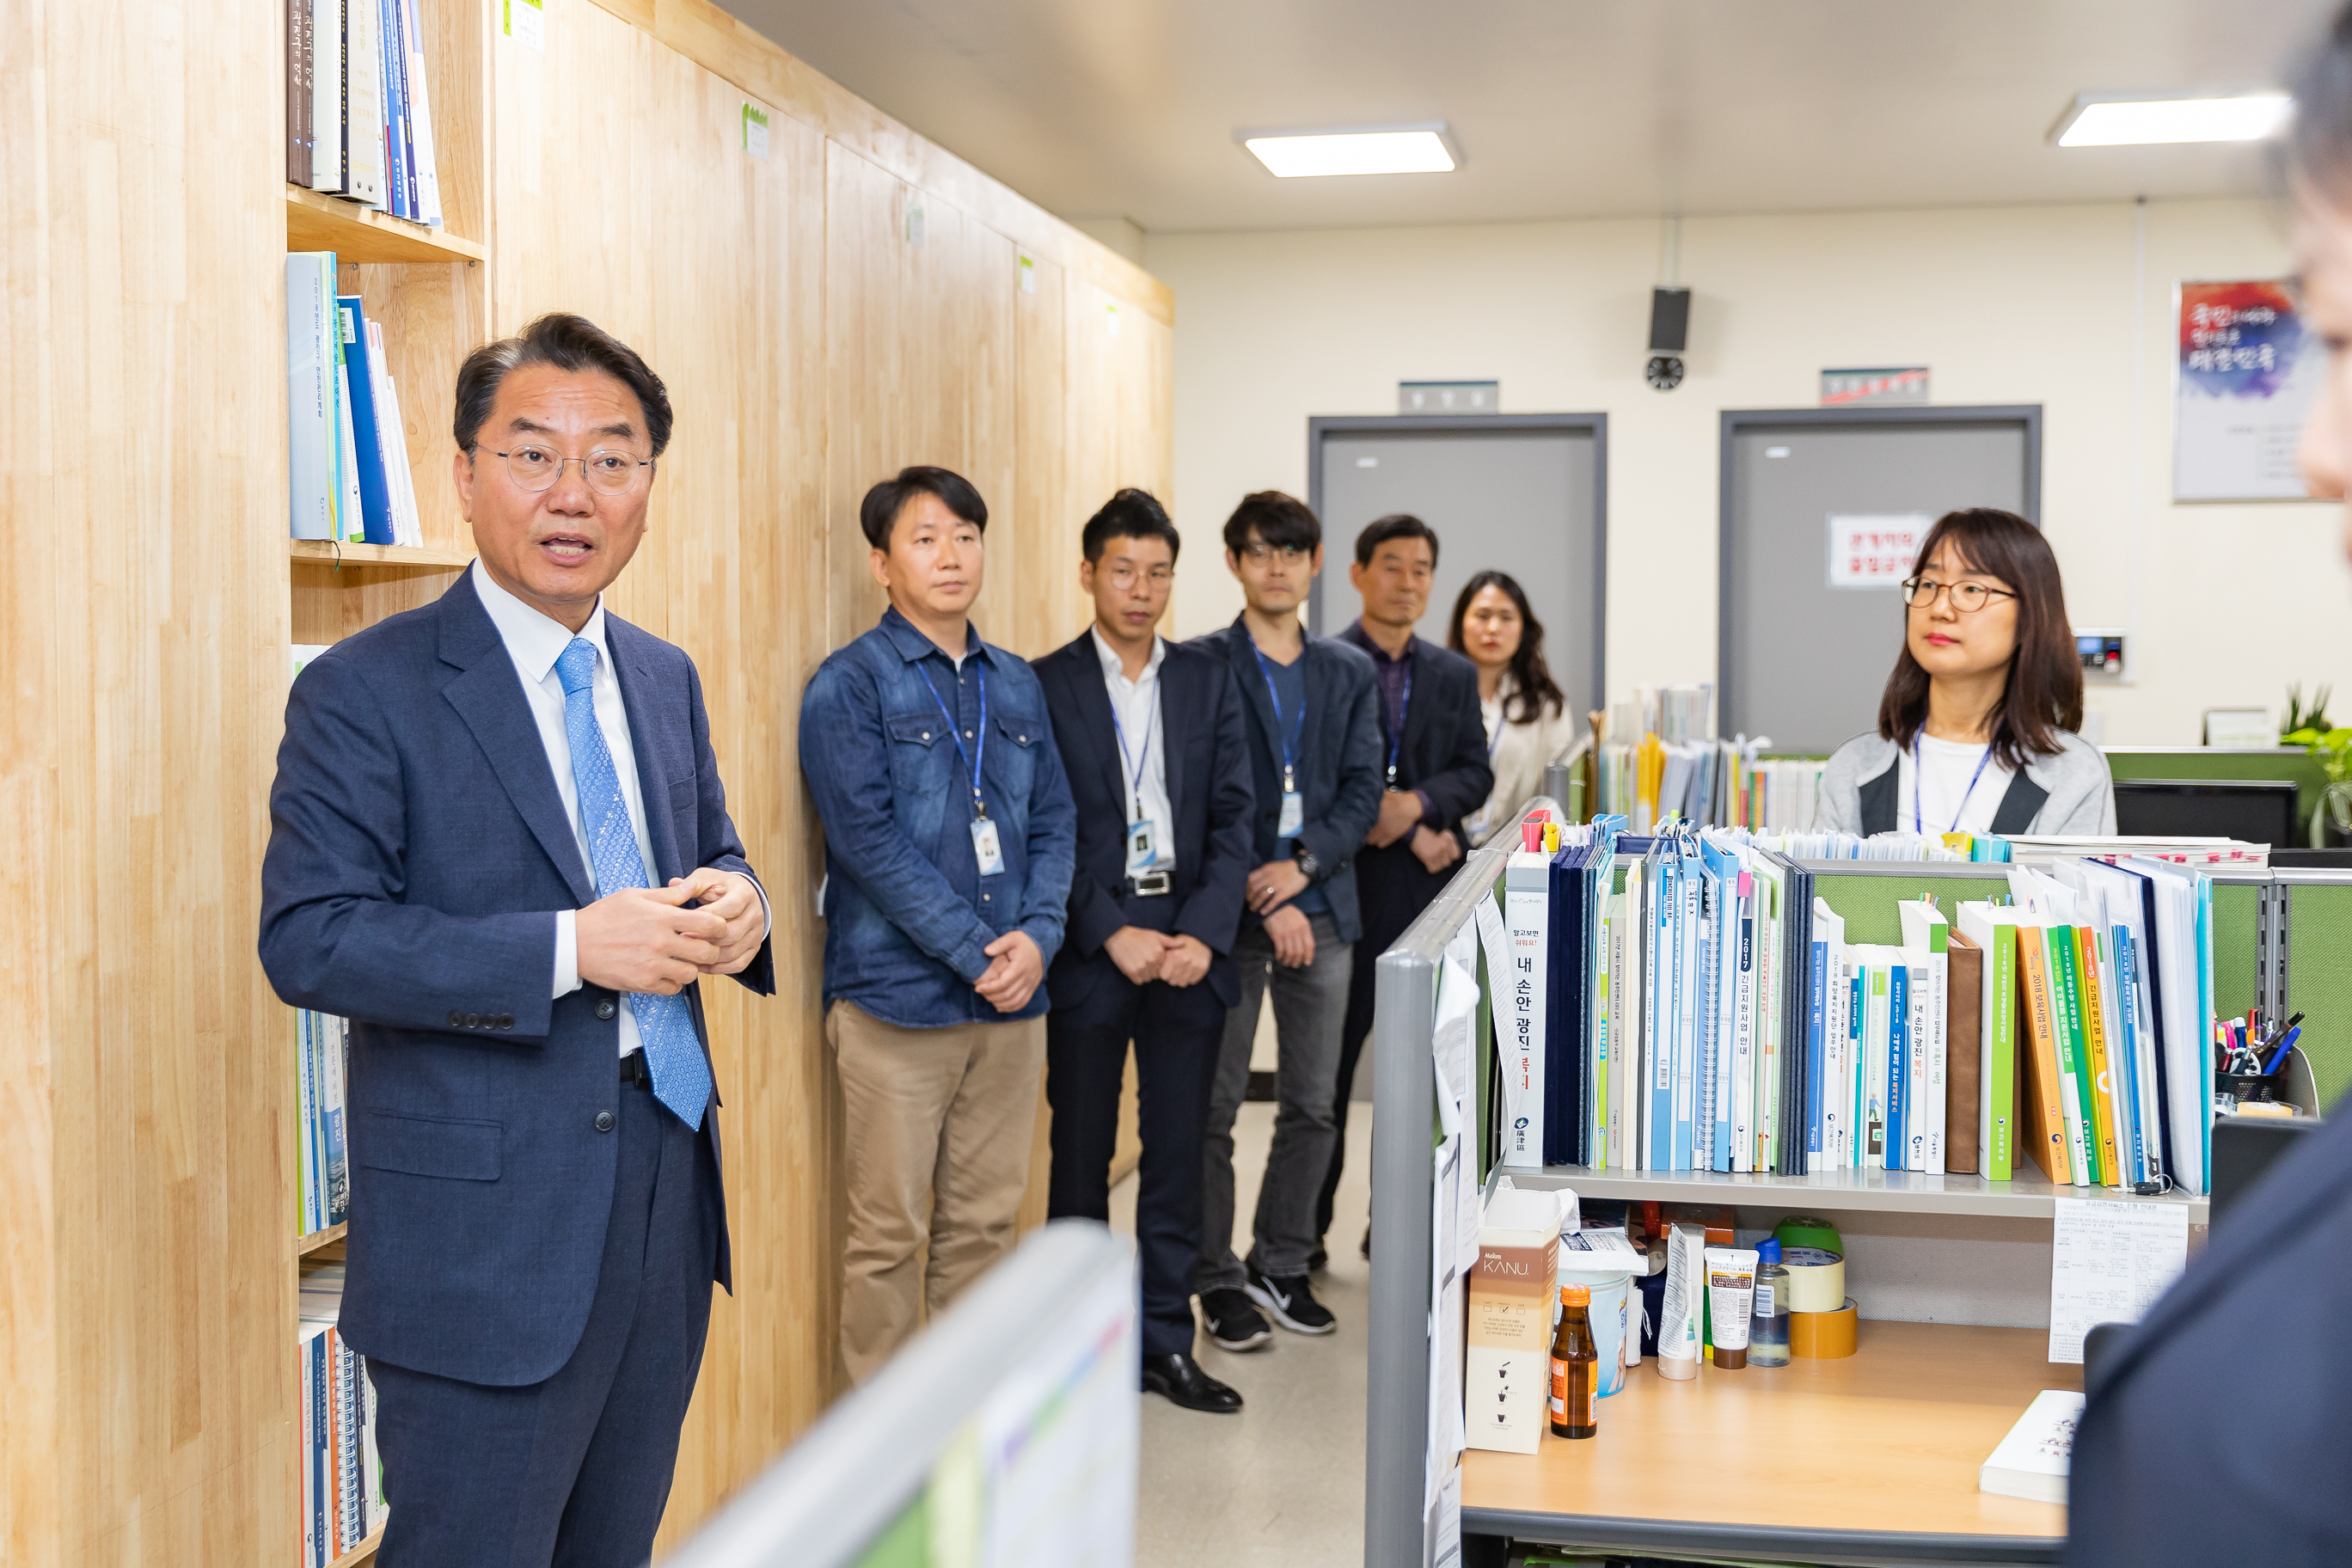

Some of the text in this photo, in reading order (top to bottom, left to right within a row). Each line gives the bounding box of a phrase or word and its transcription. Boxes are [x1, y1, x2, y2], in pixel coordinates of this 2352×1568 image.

[292, 10, 302, 58] 광진구의
[303, 15, 313, 64] 광진구의
[294, 62, 303, 87] 역사
[305, 67, 313, 90] 역사
[1761, 991, 1767, 1001] 사업
[2066, 975, 2075, 1001] 아동수당
[2086, 946, 2104, 1056] 2018년 긴급지원사업 안내
[1516, 957, 1532, 1050] 내 손안 광진
[1740, 975, 1749, 1032] 긴급지원사업
[2032, 974, 2049, 1039] 2018 보육사업 안내
[2053, 947, 2073, 1063] 2018년도 아이돌봄 지원사업 안내
[2068, 1002, 2077, 1015] 사업
[2070, 1017, 2079, 1031] 안내
[1739, 1037, 1748, 1056] 안내
[1913, 1005, 1924, 1078] 내 손안 광진 복지
[2083, 1128, 2092, 1161] 보건복지부
[1484, 1252, 1502, 1260] Maxim
[306, 1430, 311, 1445] 안내
